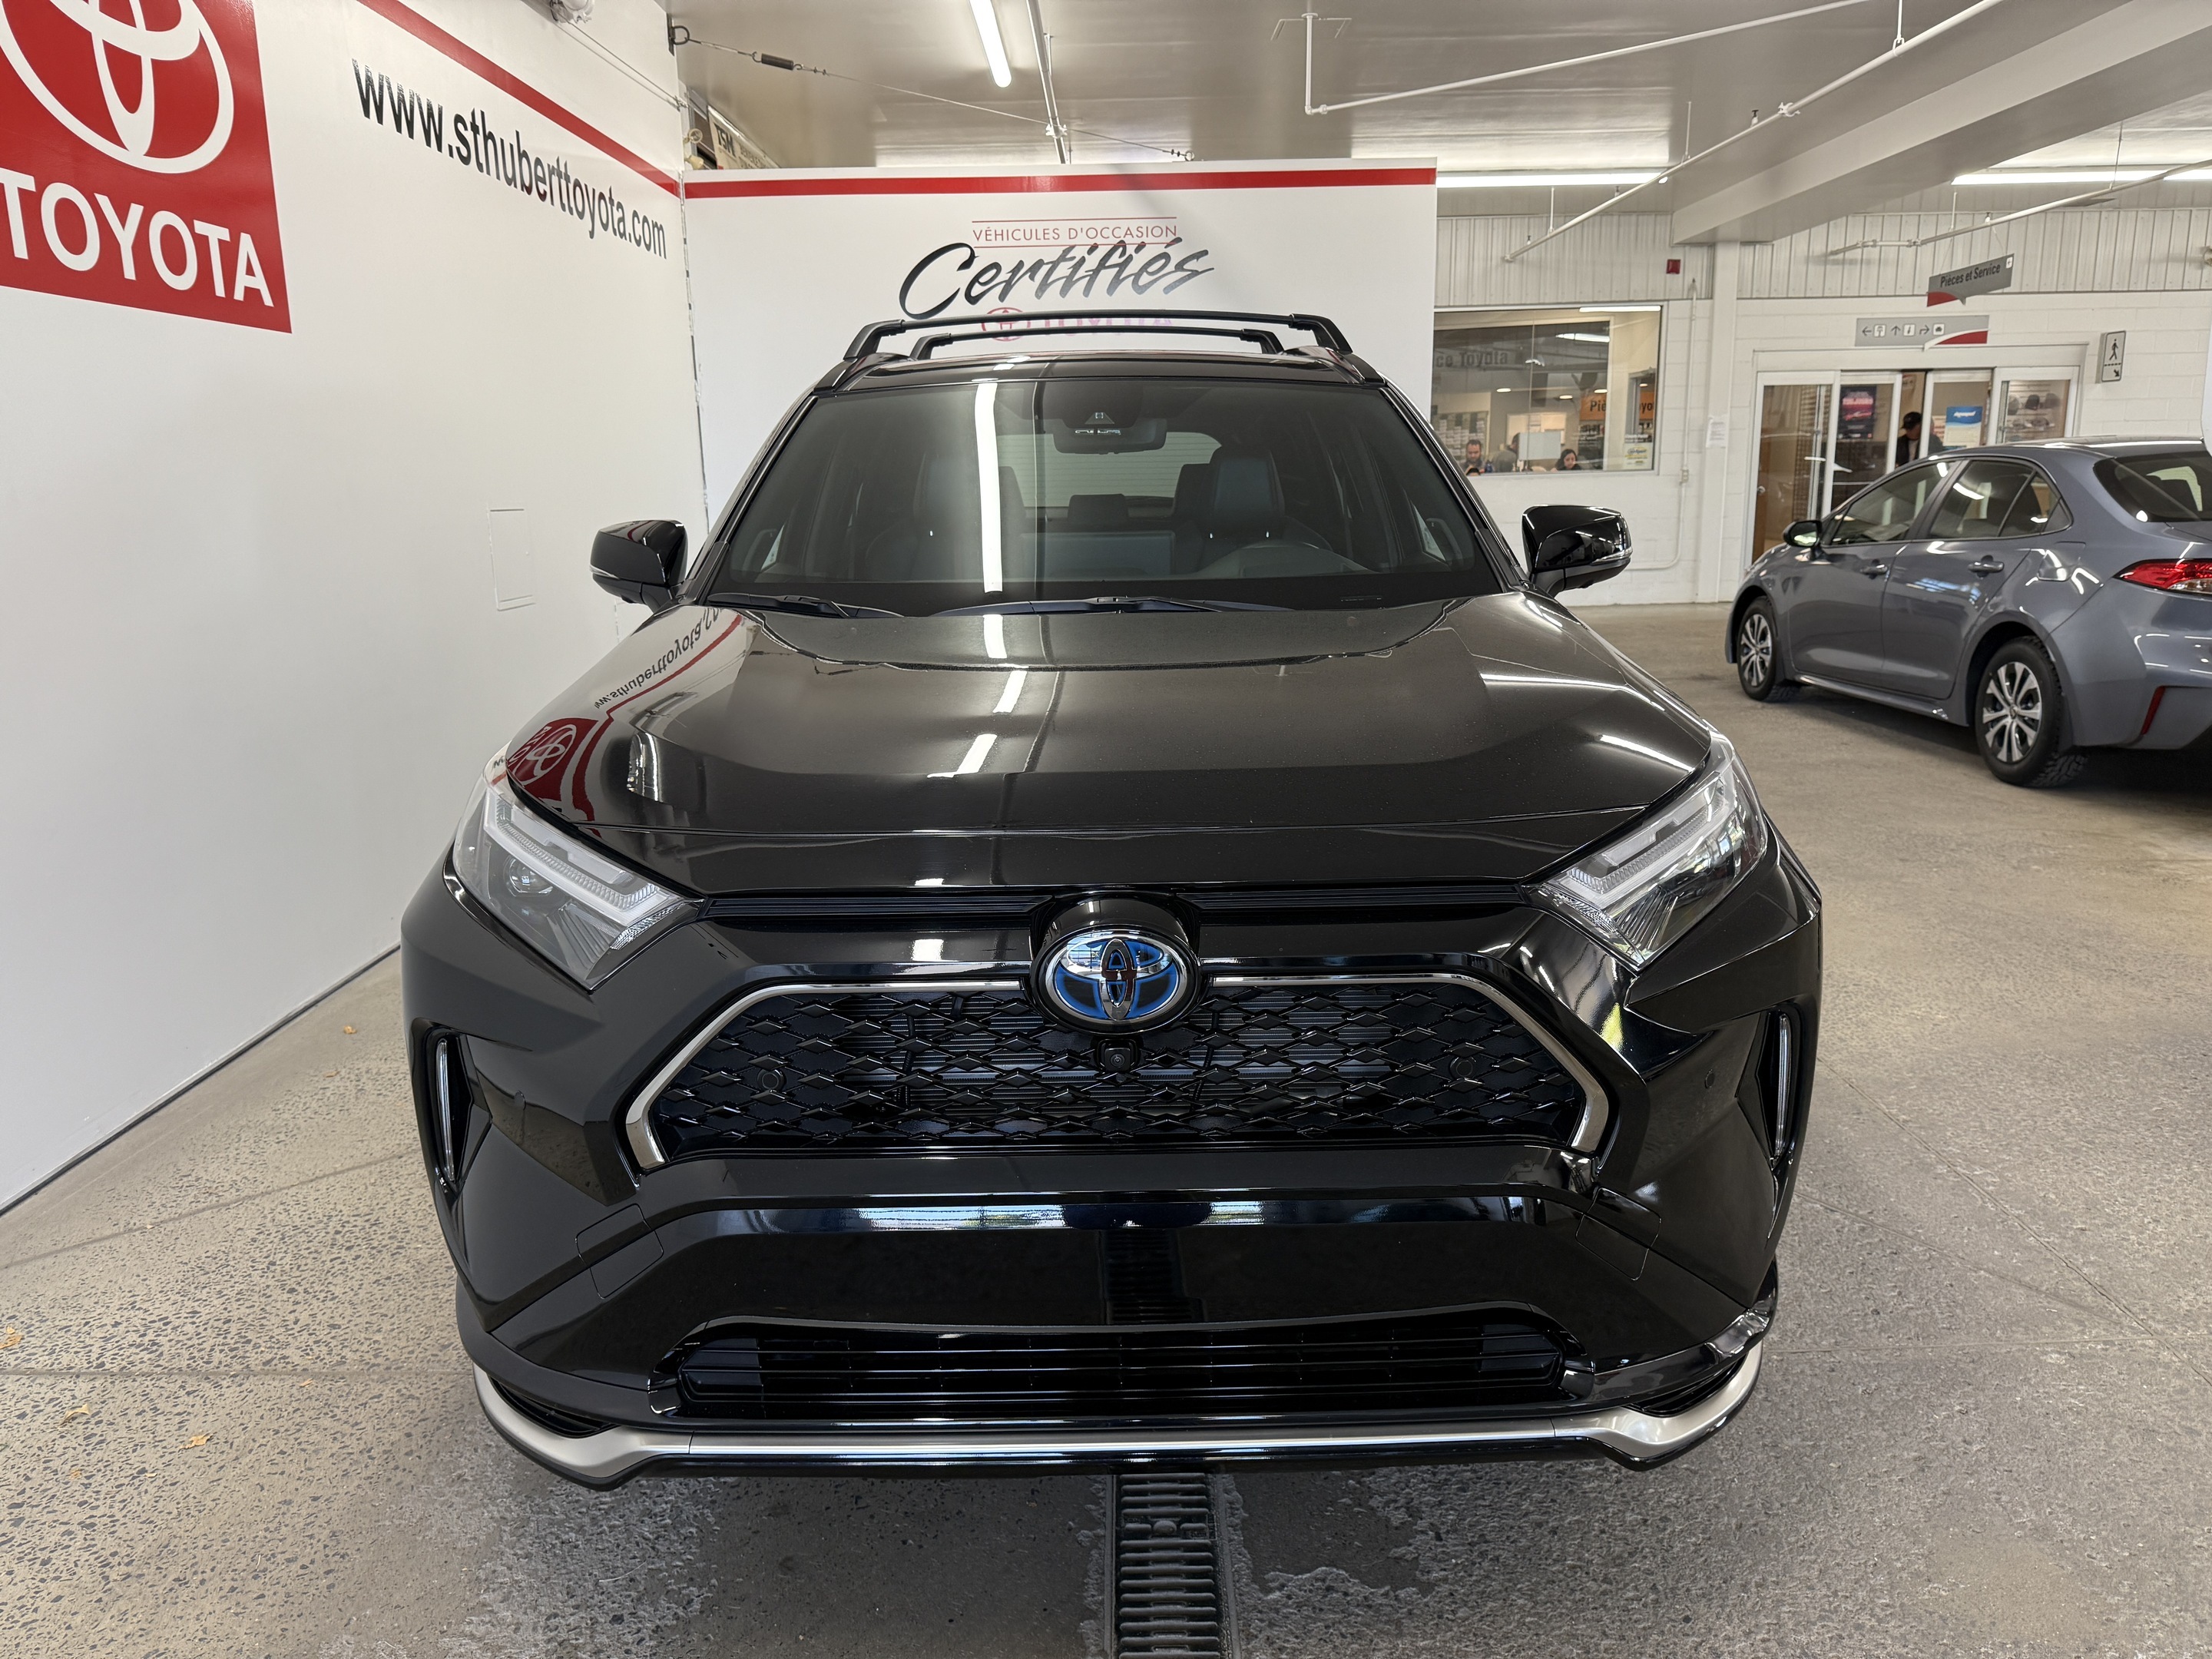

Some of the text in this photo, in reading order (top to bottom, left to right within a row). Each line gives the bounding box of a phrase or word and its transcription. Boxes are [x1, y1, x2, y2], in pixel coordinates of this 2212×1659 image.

[351, 58, 667, 259] www.sthuberttoyota.com
[0, 167, 274, 307] TOYOTA
[972, 225, 1177, 242] VÉHICULES D'OCCASION
[899, 237, 1214, 320] Certifiés
[1940, 263, 2001, 288] Pièces et Service
